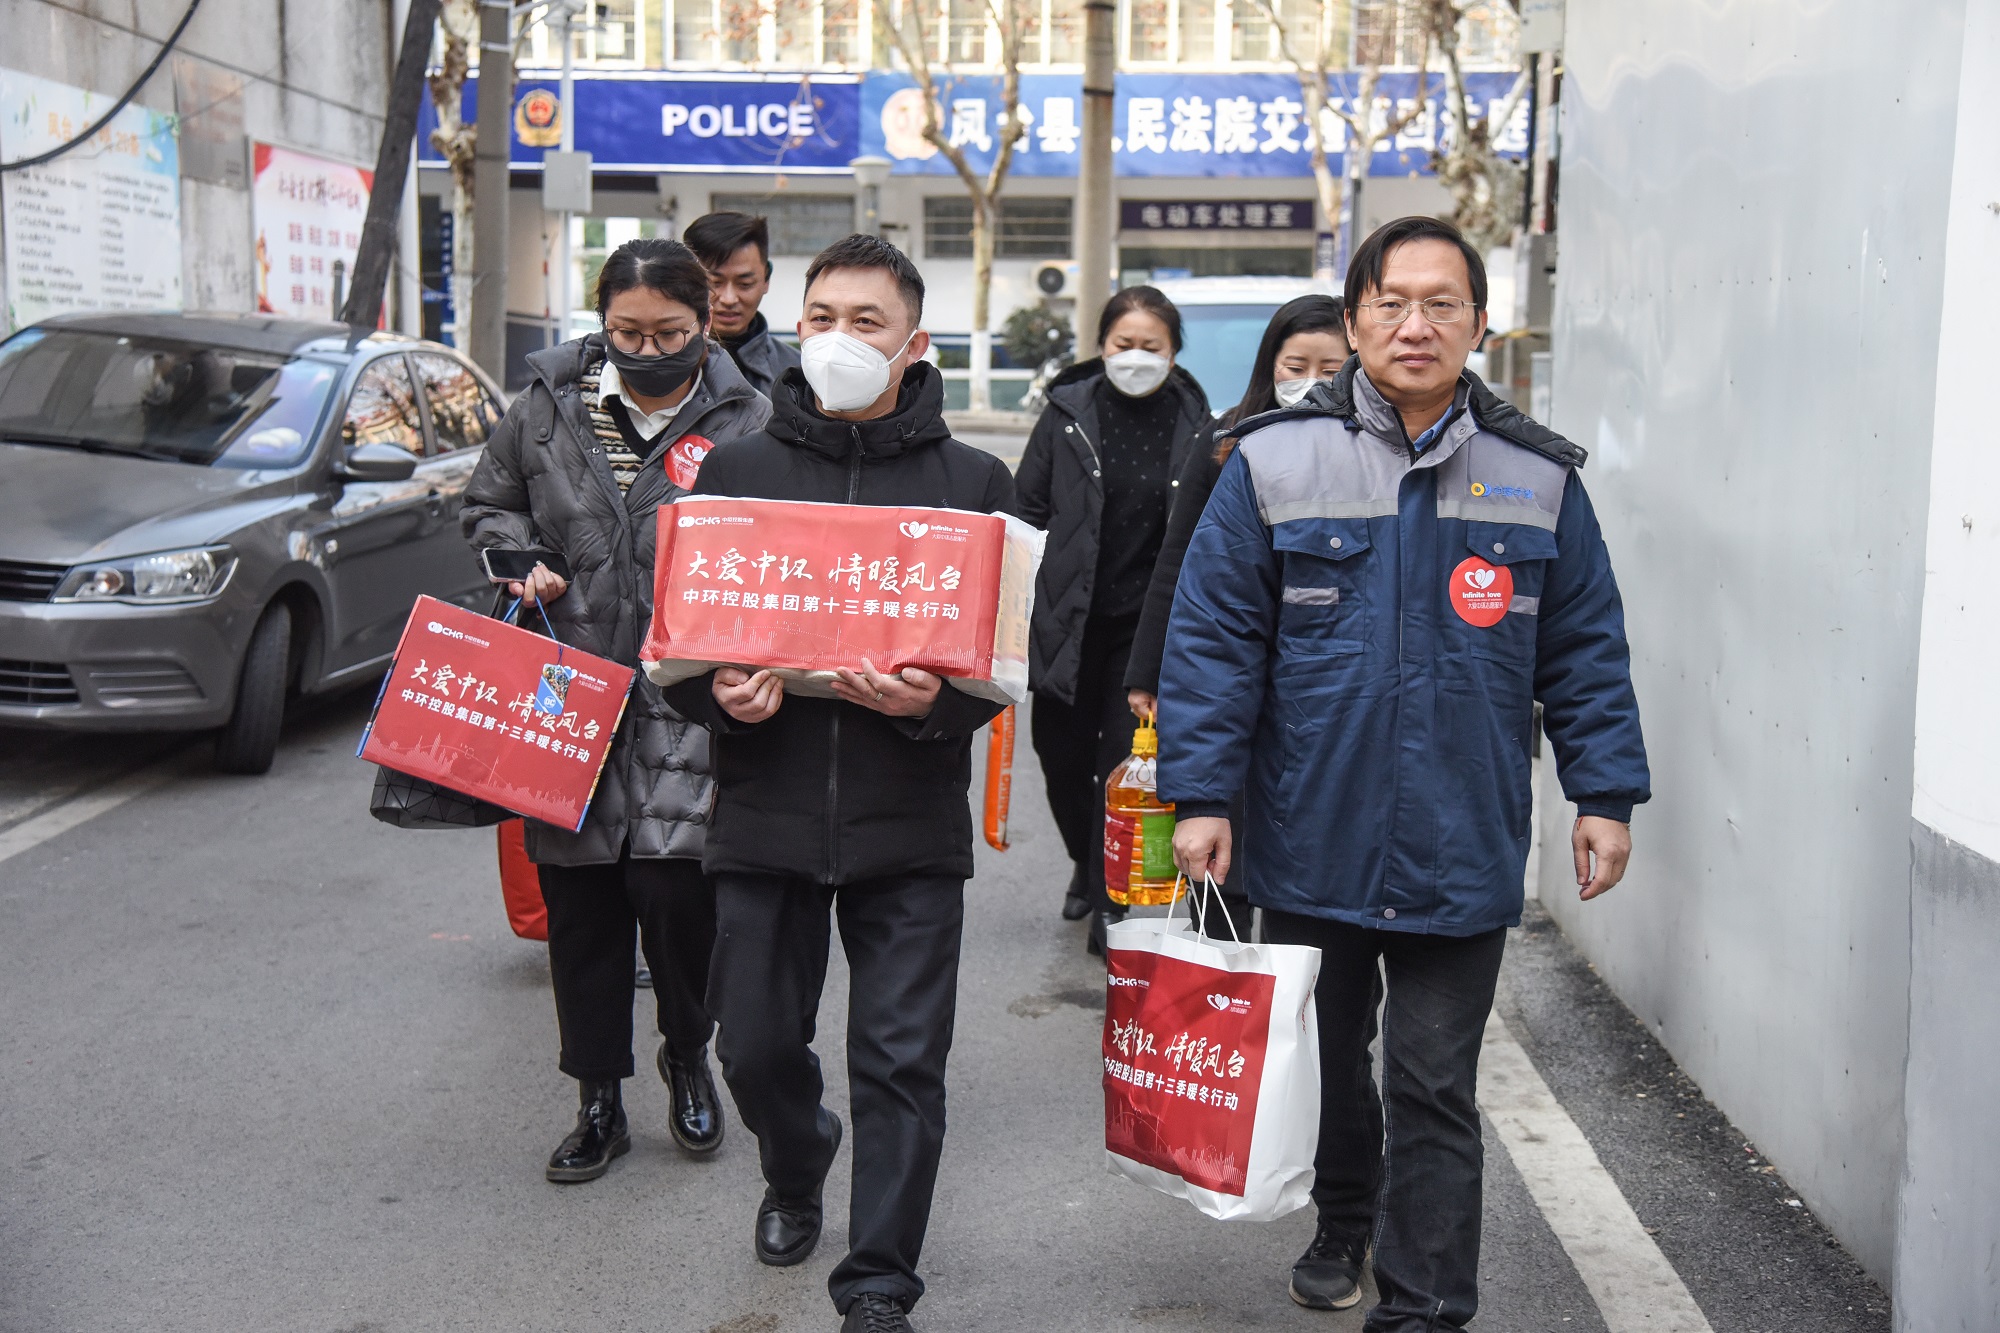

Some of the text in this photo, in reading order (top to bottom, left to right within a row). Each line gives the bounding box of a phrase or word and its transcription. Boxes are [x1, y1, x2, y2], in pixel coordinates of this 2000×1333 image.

[662, 103, 815, 138] POLICE
[949, 96, 1530, 154] 凤台县民法院交通巡回庭
[1141, 203, 1293, 229] 电动车处理室
[695, 516, 720, 526] CHG
[930, 524, 953, 532] Infinite
[686, 547, 962, 595] 大爱中环 情暖凤台
[683, 588, 960, 620] 中环控股集团第十三季暖冬行动
[1462, 591, 1485, 599] Infinite
[442, 626, 464, 640] CHG
[410, 658, 498, 706] 大爱中环
[401, 688, 591, 763] 中环控股集团第十三季暖冬行动
[1116, 977, 1138, 987] CHG
[1164, 1031, 1245, 1078] 情暖凤台
